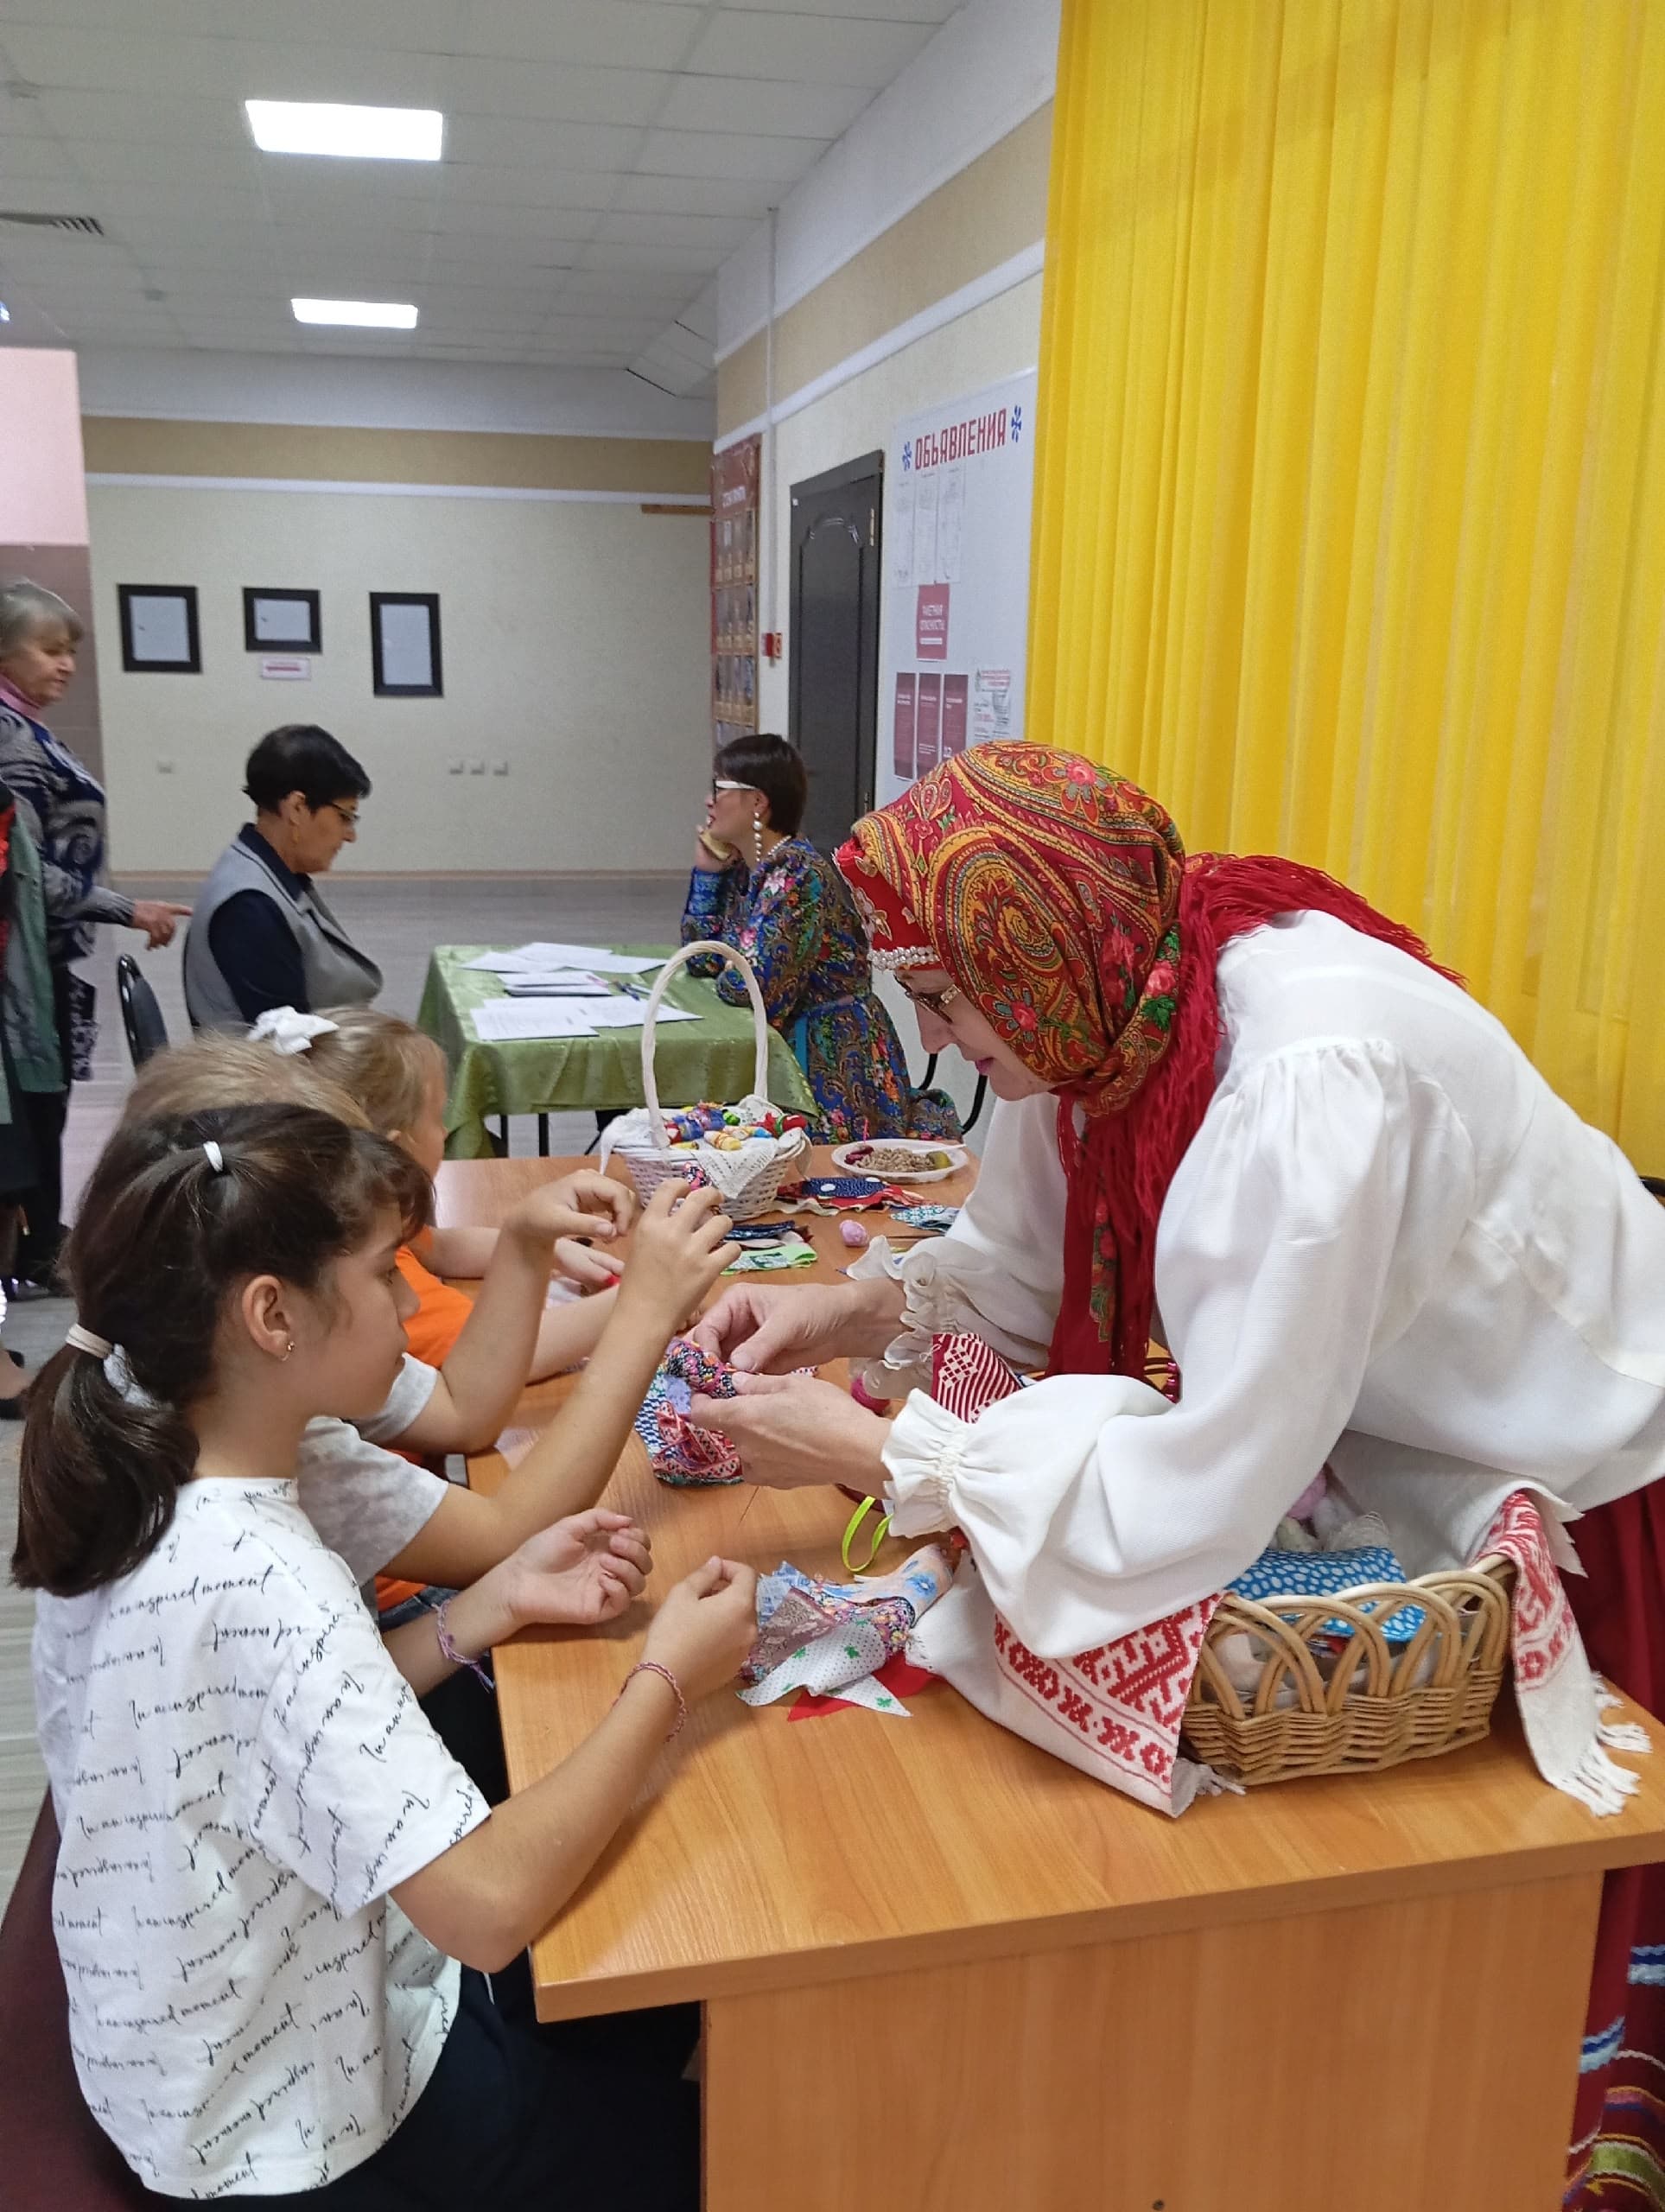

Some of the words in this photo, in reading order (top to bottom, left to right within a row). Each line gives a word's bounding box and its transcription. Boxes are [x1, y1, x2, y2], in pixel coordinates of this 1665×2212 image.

[201, 1563, 284, 1595] moment
[200, 1618, 270, 1653] moment
[341, 1669, 365, 1696] In
[129, 1699, 151, 1731] In
[321, 1697, 342, 1728] an
[359, 1741, 388, 1764] In
[385, 1712, 404, 1737] an
[401, 1789, 431, 1817] In
[76, 1815, 98, 1842] In
[384, 1817, 404, 1850] an
[315, 1919, 379, 1974] inspired
[179, 1976, 248, 2018] moment
[242, 2000, 303, 2064] moment
[334, 2055, 360, 2084] In
[361, 2044, 382, 2066] an
[188, 2110, 252, 2166] moment
[294, 2118, 315, 2149] In
